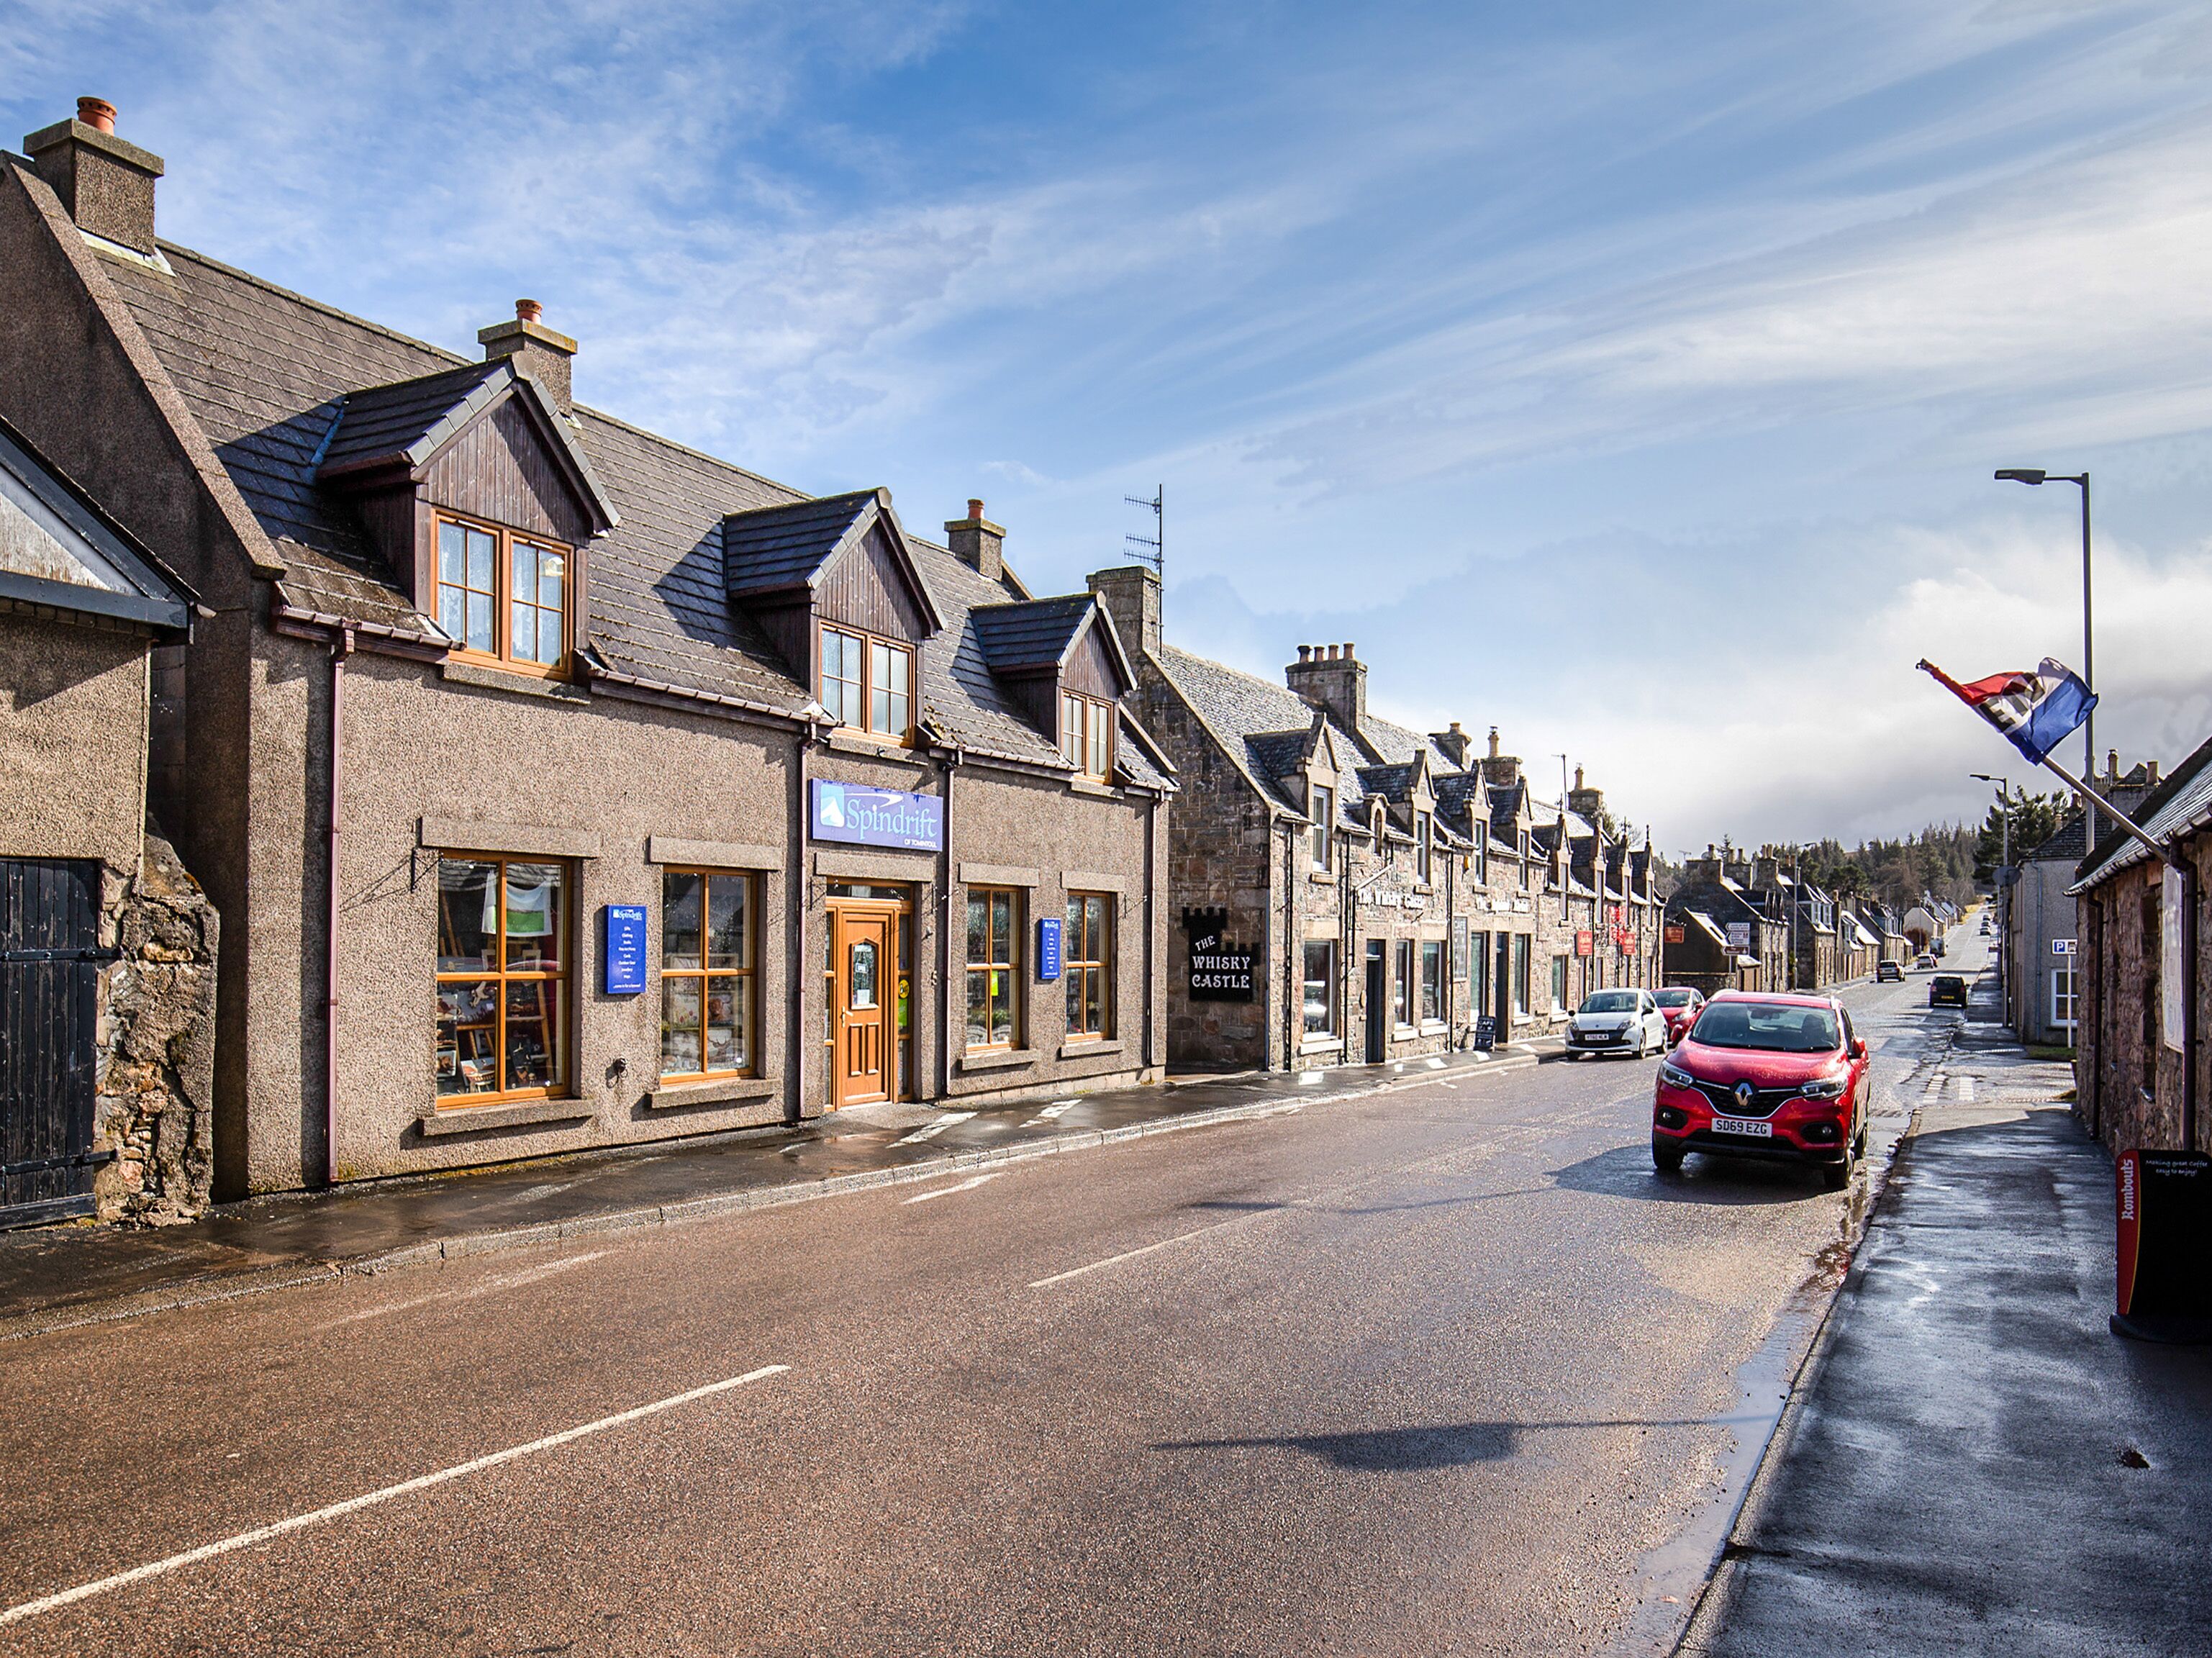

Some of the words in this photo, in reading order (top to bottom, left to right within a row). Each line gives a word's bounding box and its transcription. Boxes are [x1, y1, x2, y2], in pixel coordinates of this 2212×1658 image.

[846, 799, 938, 841] Spindrift
[912, 839, 937, 848] TOMINTOUL
[1195, 935, 1216, 951] THE
[2057, 942, 2064, 951] P
[1192, 955, 1251, 970] WHISKY
[1192, 973, 1251, 989] CASTLE
[1716, 1120, 1744, 1132] SD69
[1746, 1123, 1767, 1135] EZG
[2120, 1159, 2134, 1220] Rombouts
